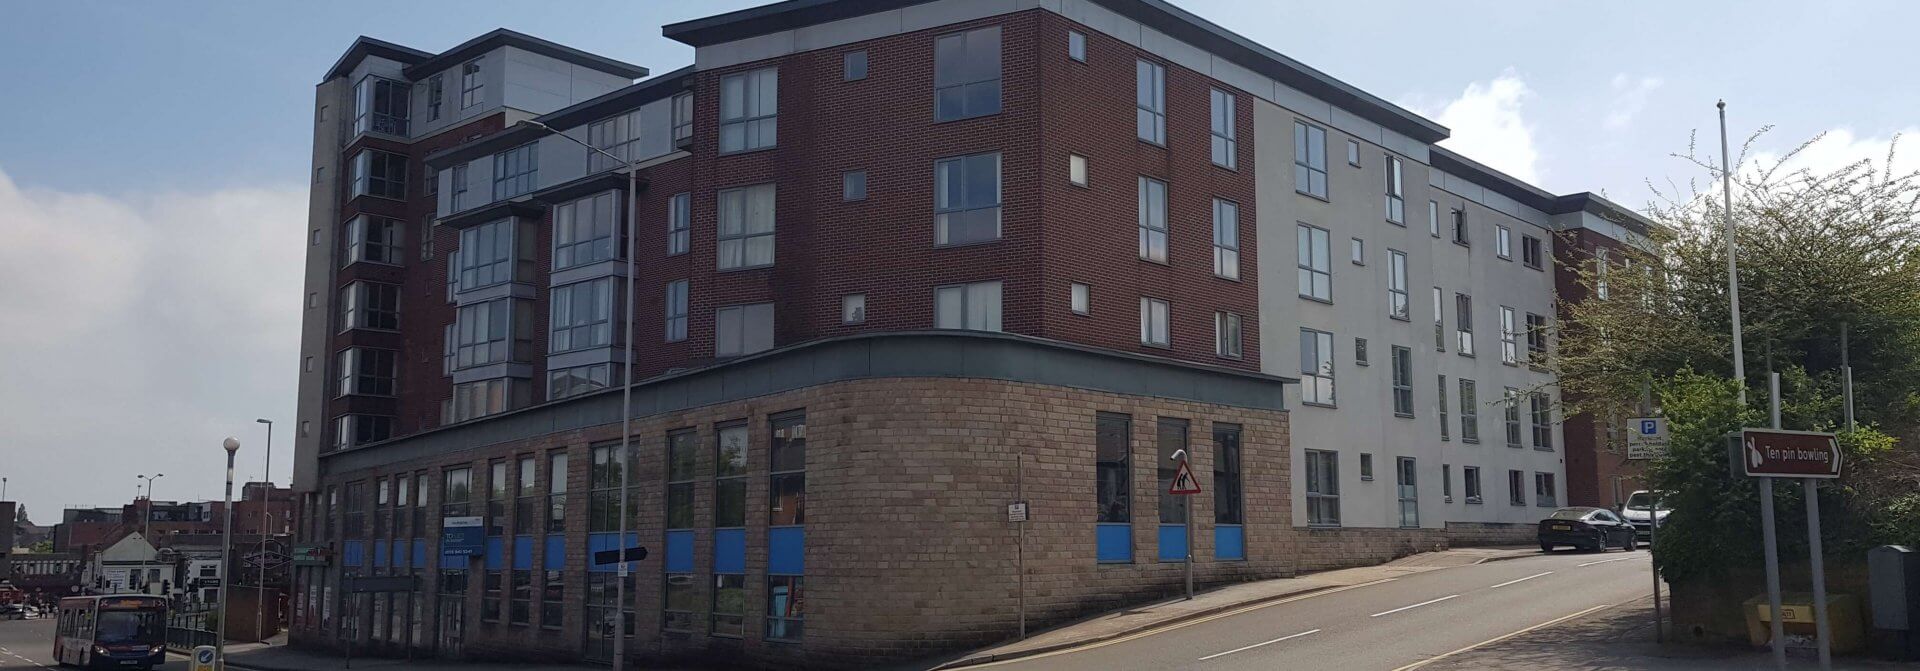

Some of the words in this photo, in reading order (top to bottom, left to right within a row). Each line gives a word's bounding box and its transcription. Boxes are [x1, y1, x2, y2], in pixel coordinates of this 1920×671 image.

[1645, 421, 1655, 434] P
[1765, 445, 1780, 459] Ten
[1783, 447, 1795, 461] pin
[1797, 447, 1829, 463] bowling
